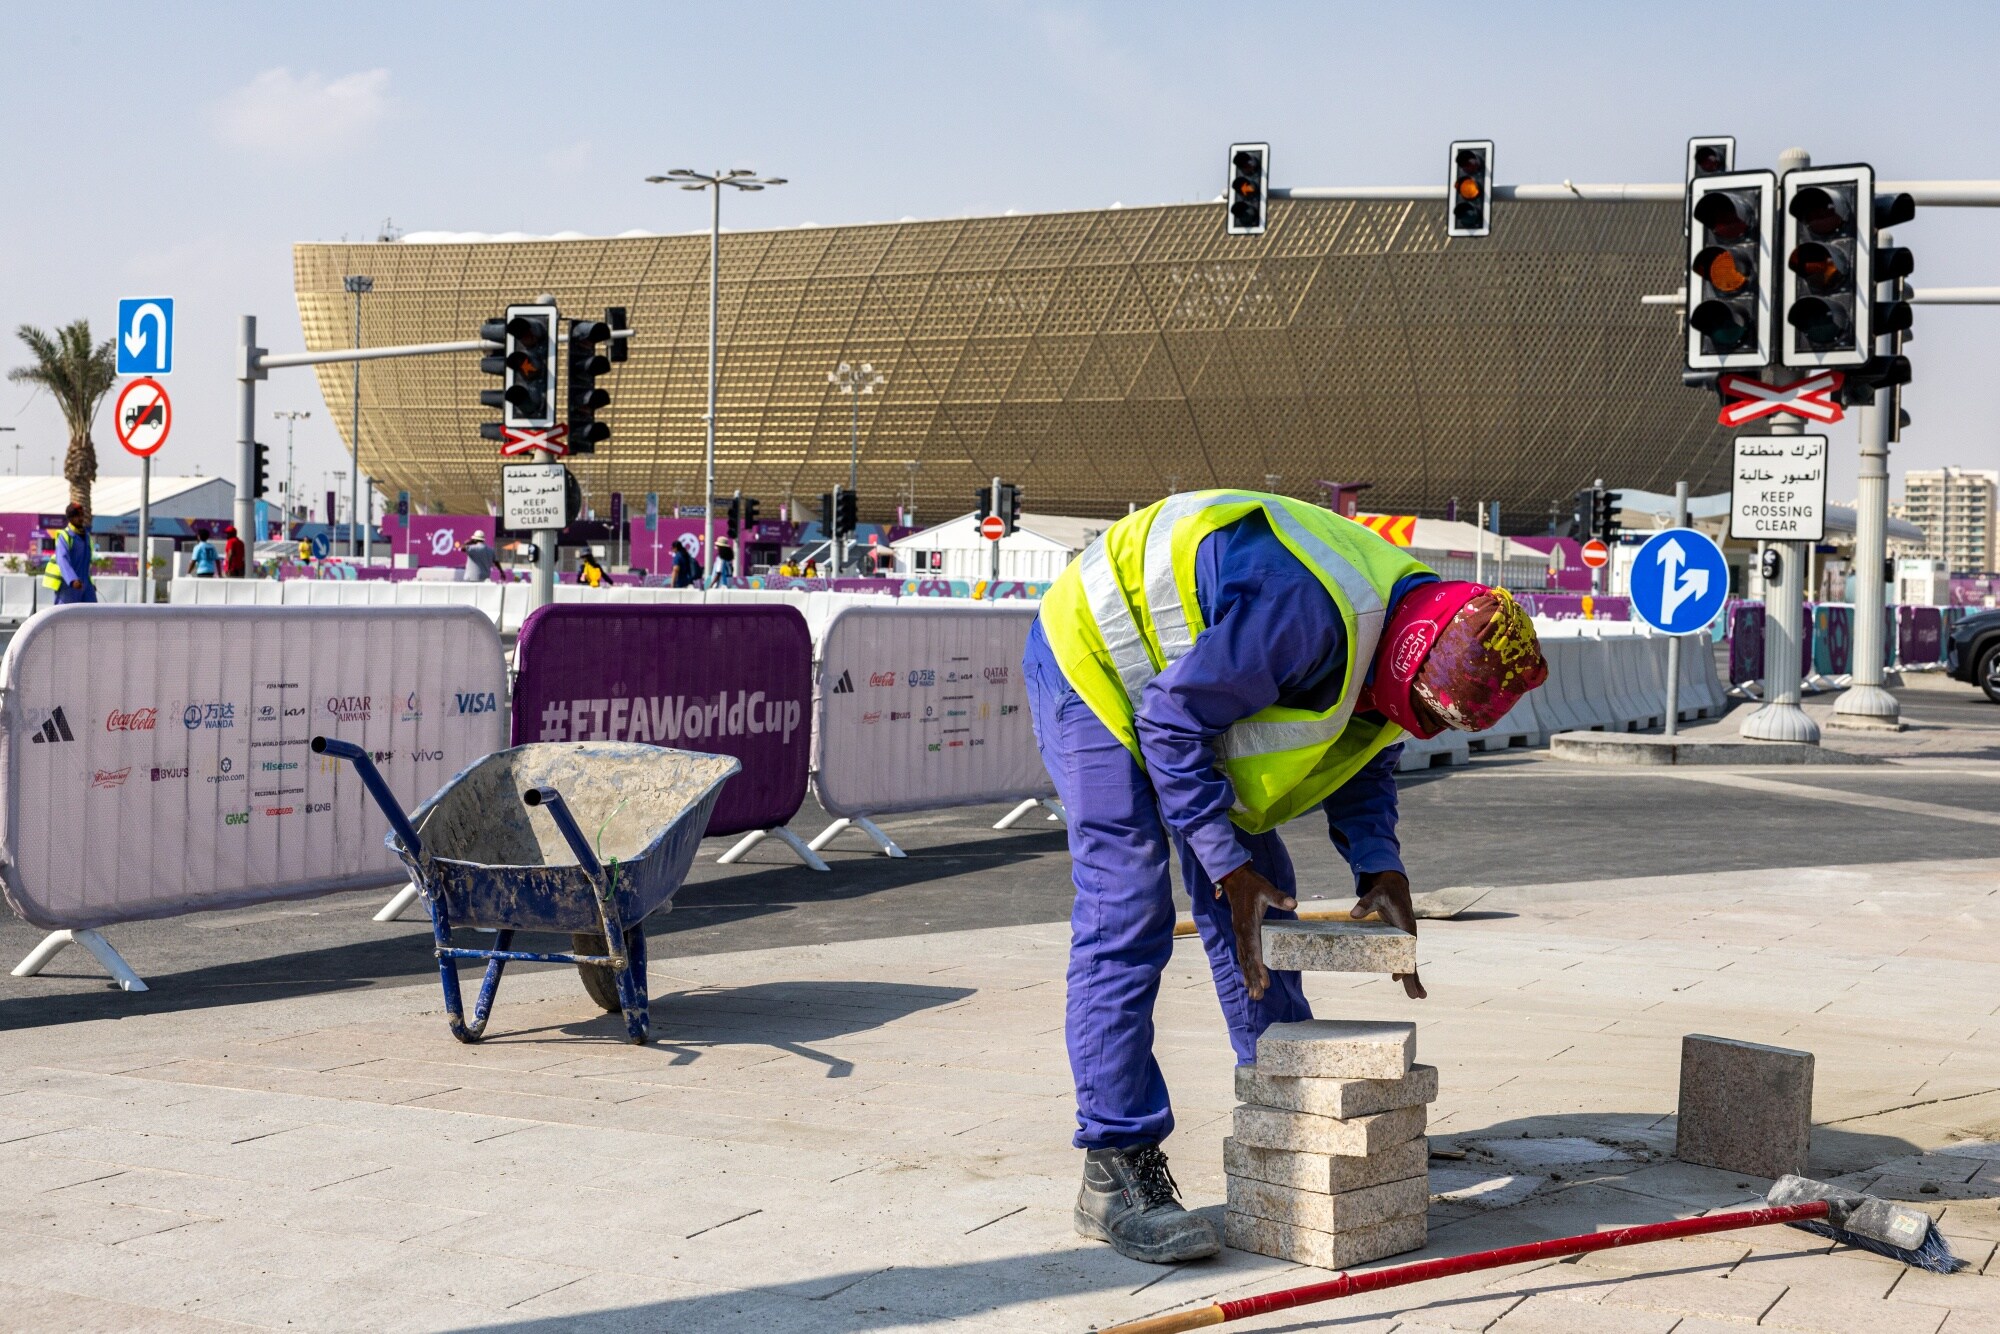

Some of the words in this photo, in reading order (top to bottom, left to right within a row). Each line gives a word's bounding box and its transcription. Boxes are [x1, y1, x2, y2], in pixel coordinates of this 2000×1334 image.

[1740, 444, 1783, 456] منطقة
[1791, 444, 1822, 460] اترك
[507, 470, 537, 478] منطقة
[1740, 468, 1774, 484] خالية
[1780, 470, 1820, 484] العبور
[508, 485, 531, 494] خالية
[536, 484, 562, 494] العبور
[1761, 492, 1794, 502] KEEP
[510, 507, 559, 516] CROSSING
[1742, 505, 1812, 518] CROSSING
[520, 516, 549, 524] CLEAR
[1756, 520, 1797, 531] CLEAR
[984, 667, 1008, 680] QATAR
[327, 696, 371, 715] QATAR
[455, 692, 496, 714] VISA
[204, 703, 234, 719] 万达
[338, 712, 371, 722] AIRWAYS
[540, 690, 800, 744] #FIFAWorldCup
[204, 720, 234, 729] WANDA
[411, 749, 444, 762] vivo
[262, 761, 298, 771] Hisense
[160, 768, 189, 779] BYJU'S
[206, 773, 244, 784] crypto.com
[314, 802, 331, 812] QNB
[225, 812, 249, 825] GWC
